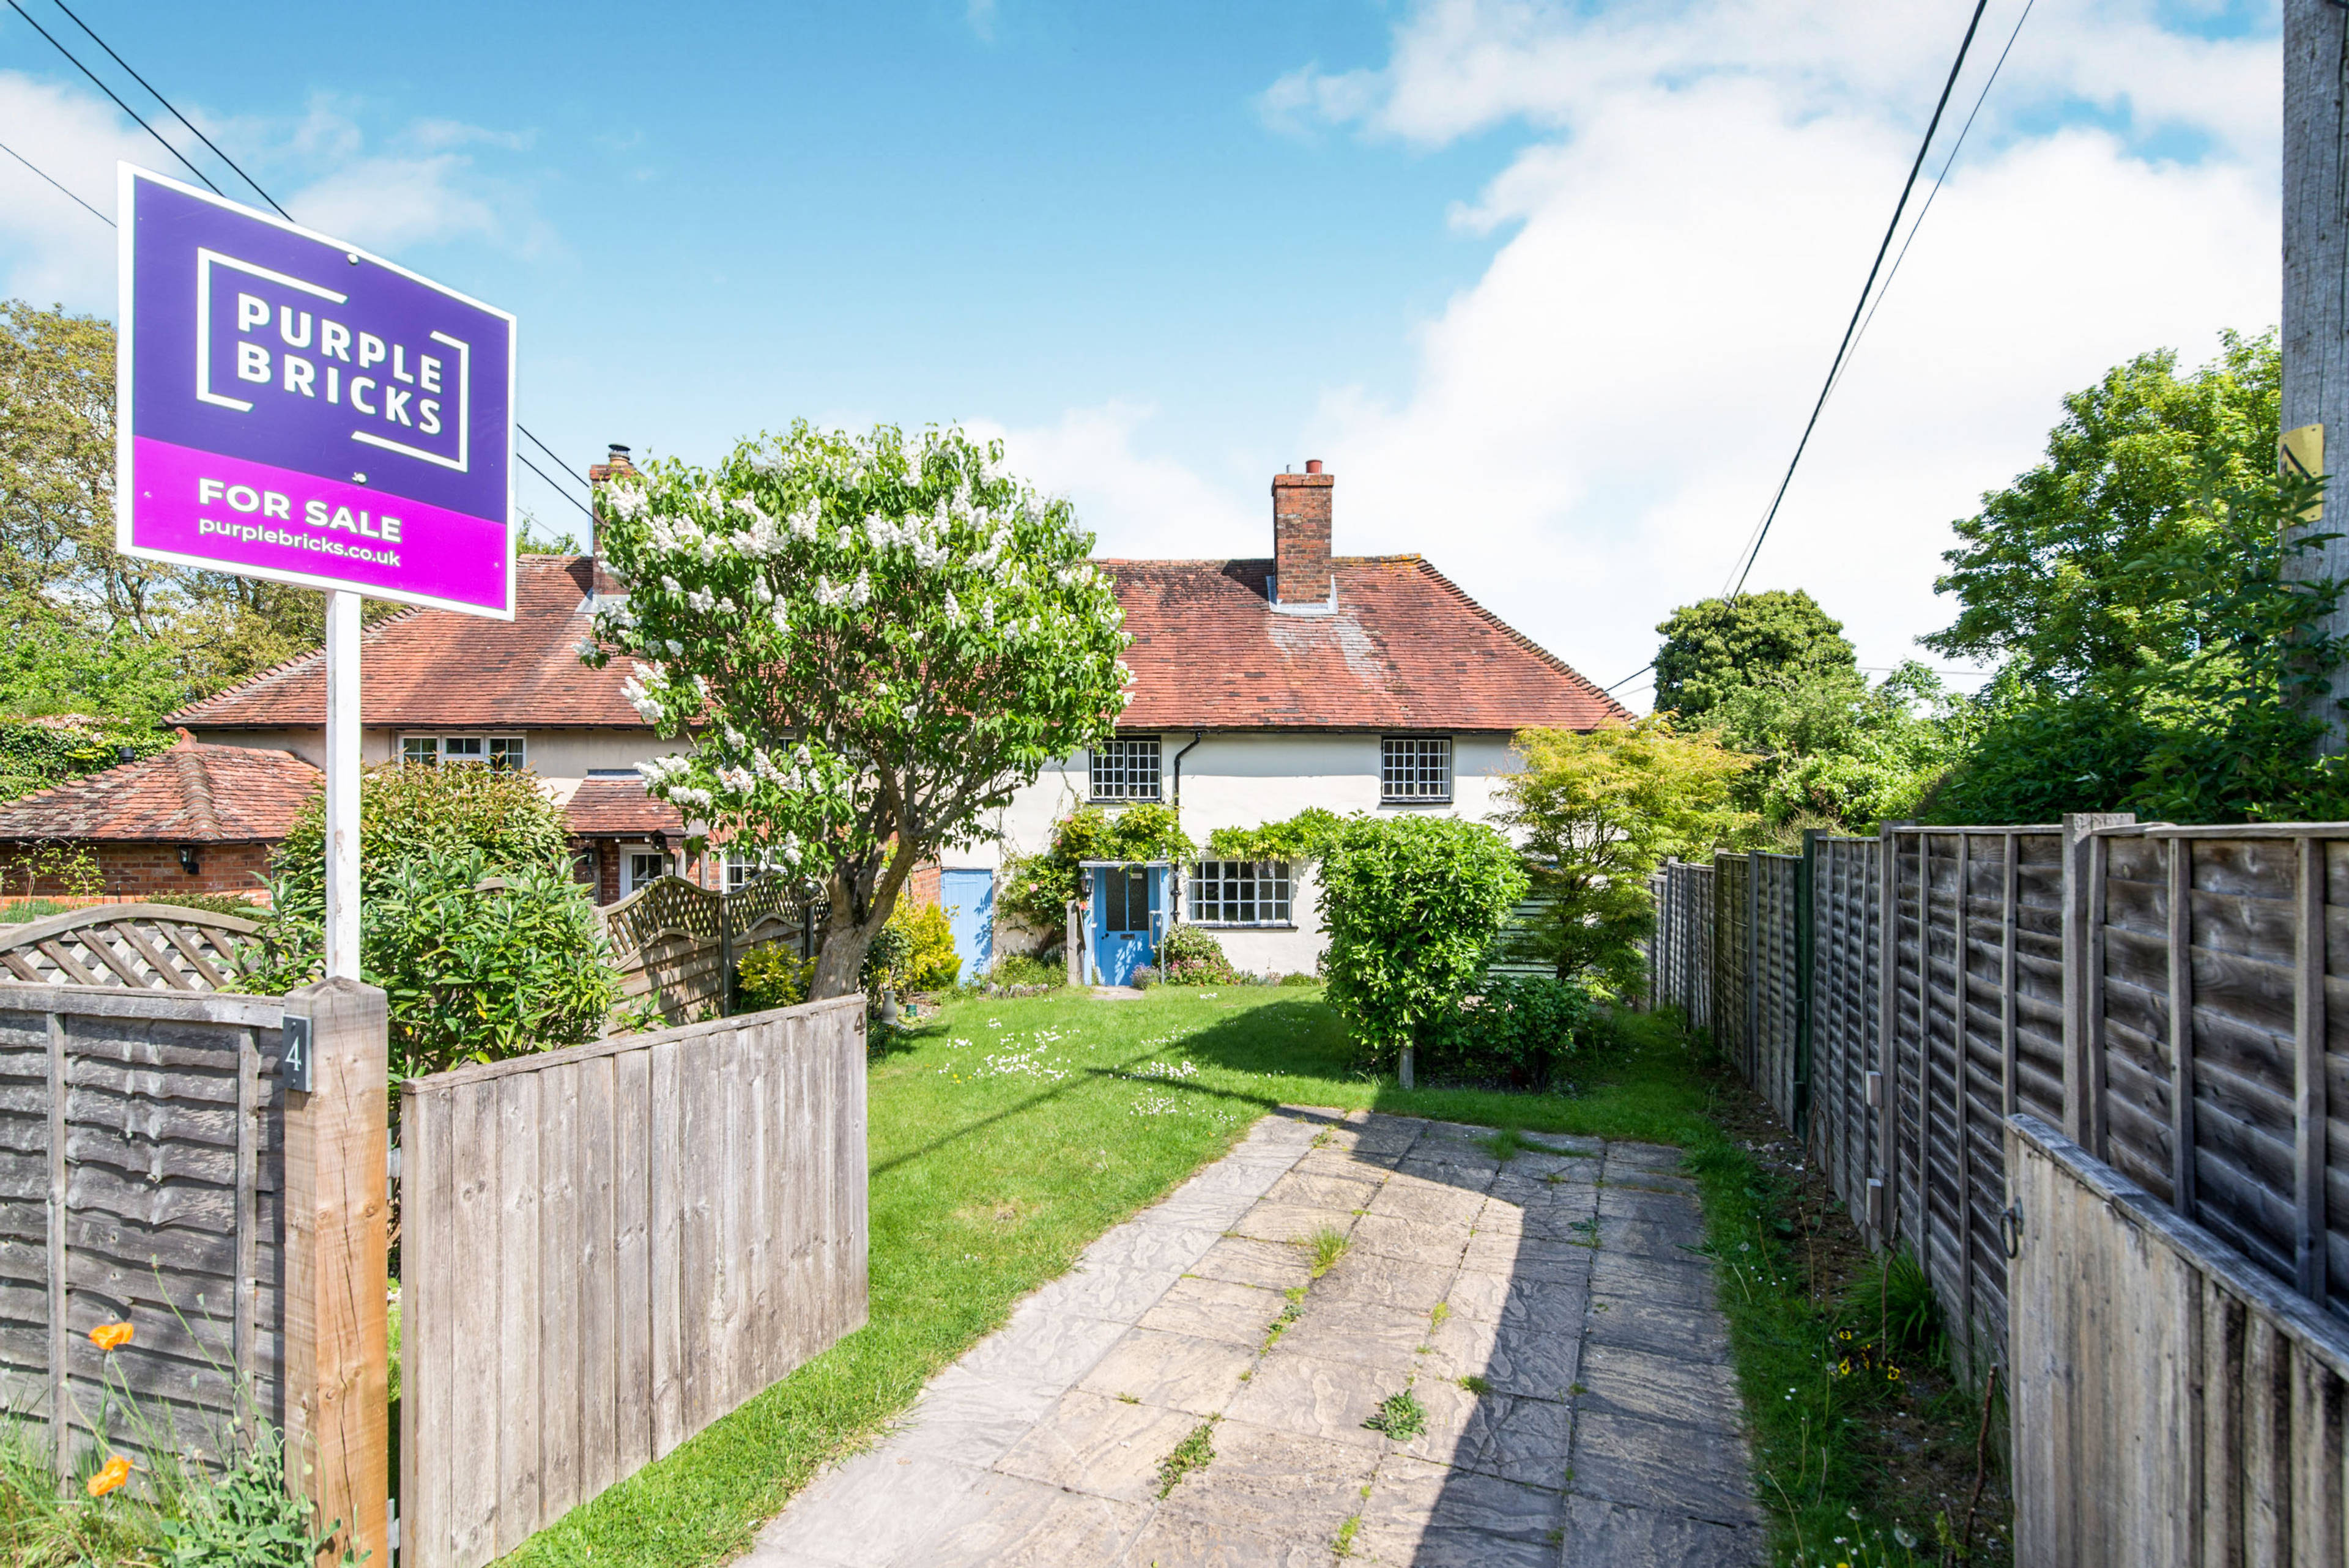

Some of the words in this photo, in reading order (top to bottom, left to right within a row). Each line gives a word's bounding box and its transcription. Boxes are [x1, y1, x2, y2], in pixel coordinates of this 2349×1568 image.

[237, 292, 442, 394] PURPLE
[237, 340, 441, 435] BRICKS
[199, 477, 291, 520] FOR
[305, 500, 402, 544] SALE
[199, 518, 401, 567] purplebricks.co.uk
[285, 1035, 302, 1071] 4
[854, 1012, 866, 1036] 4
